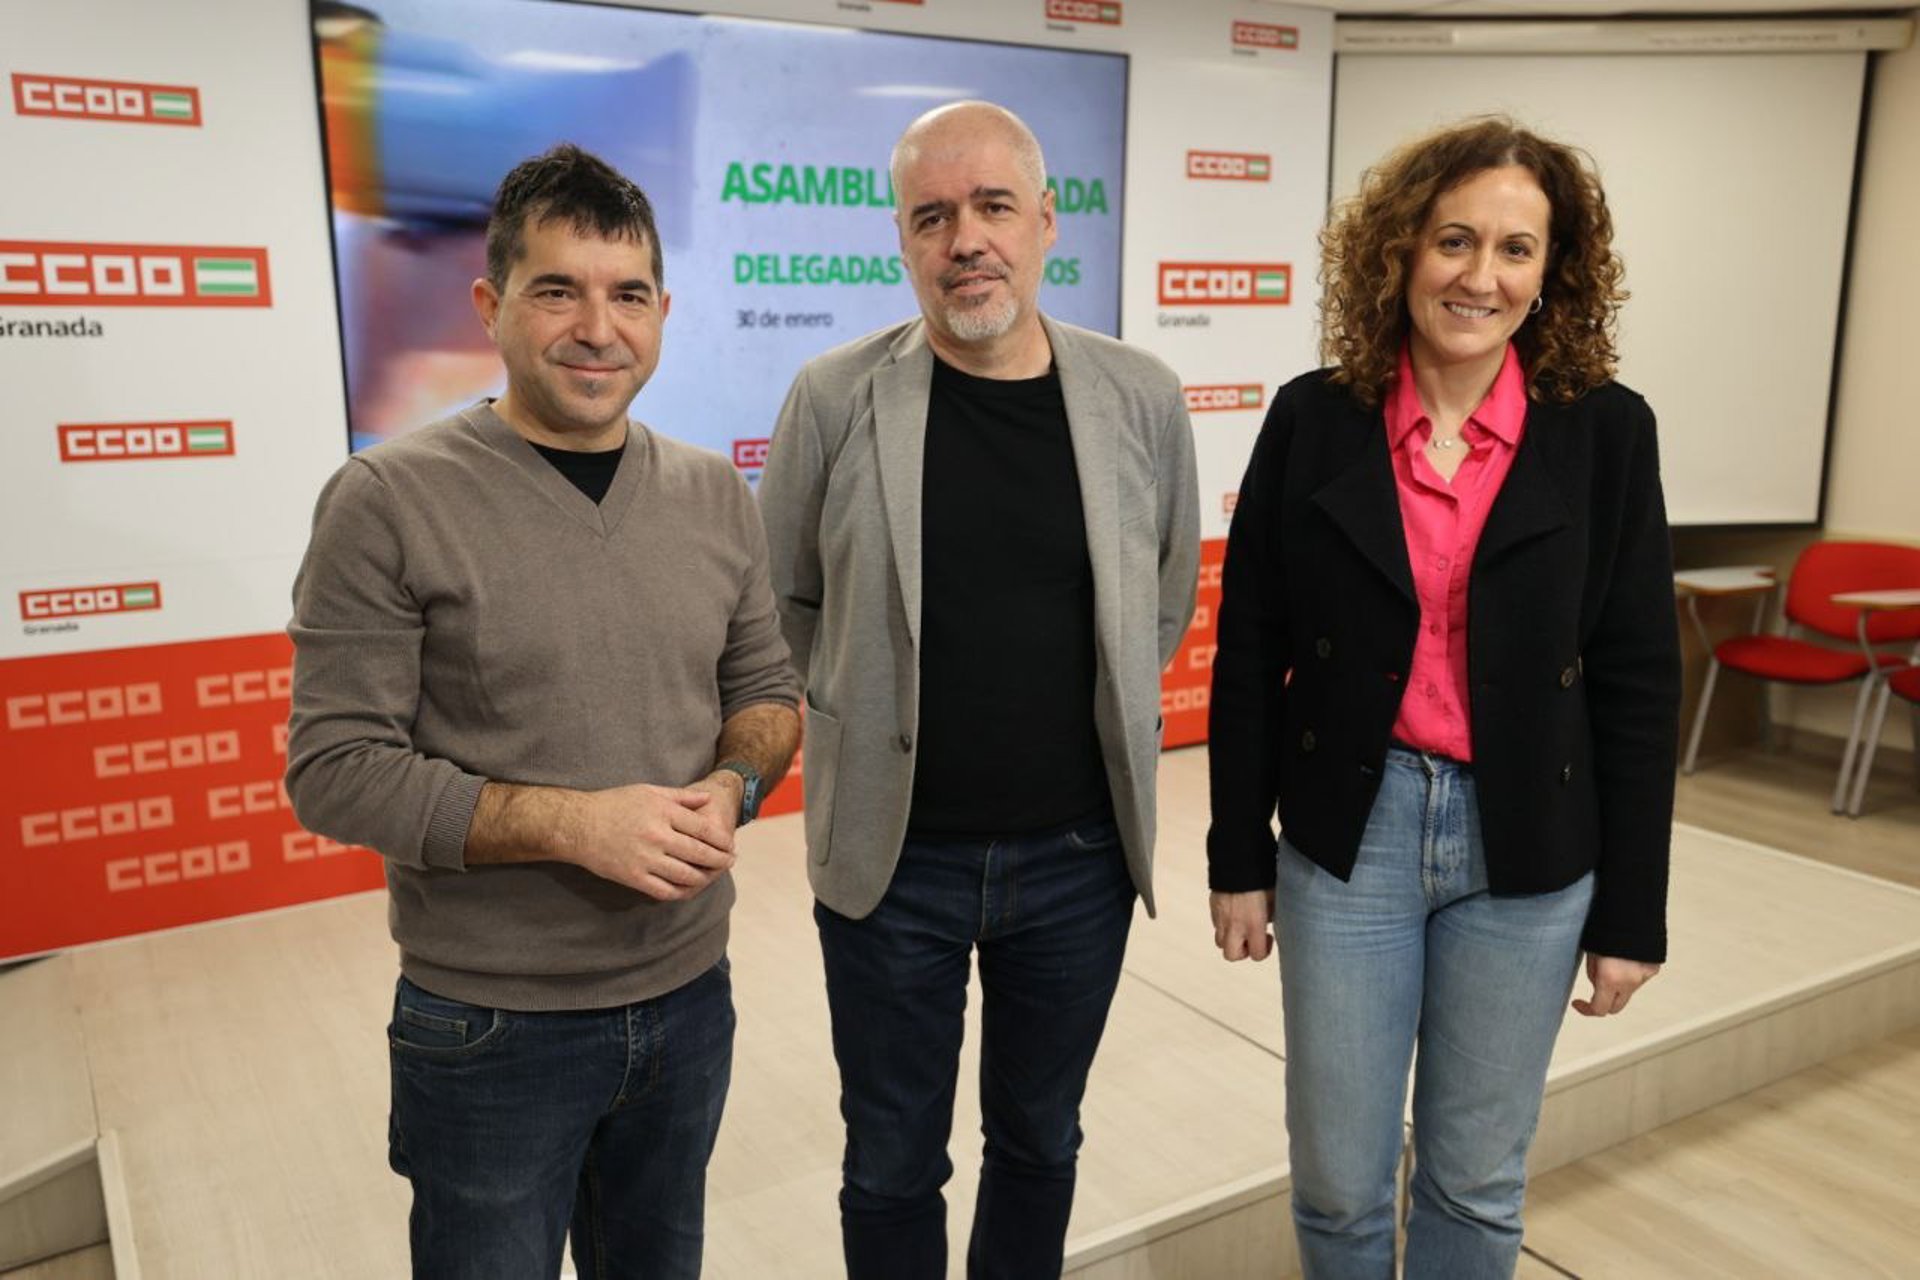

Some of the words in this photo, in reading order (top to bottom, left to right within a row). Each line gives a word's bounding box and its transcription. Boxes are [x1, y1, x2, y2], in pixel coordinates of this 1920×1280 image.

[21, 81, 145, 117] CCOO
[1190, 154, 1246, 176] CCOO
[720, 162, 896, 208] ASAMBL
[0, 253, 185, 296] CCOO
[734, 254, 903, 285] DELEGADAS
[1162, 270, 1250, 299] CCOO
[737, 310, 756, 328] 30
[759, 309, 780, 328] de
[785, 313, 834, 328] enero
[1158, 314, 1210, 327] Granada
[1185, 390, 1240, 409] CCOO
[65, 428, 182, 456] CCOO
[26, 589, 119, 616] CCOO
[6, 682, 163, 730] CCOO
[196, 667, 294, 708] CCO
[94, 730, 240, 778] CCOO
[20, 796, 174, 847] CCOO
[106, 840, 251, 892] CCOO
